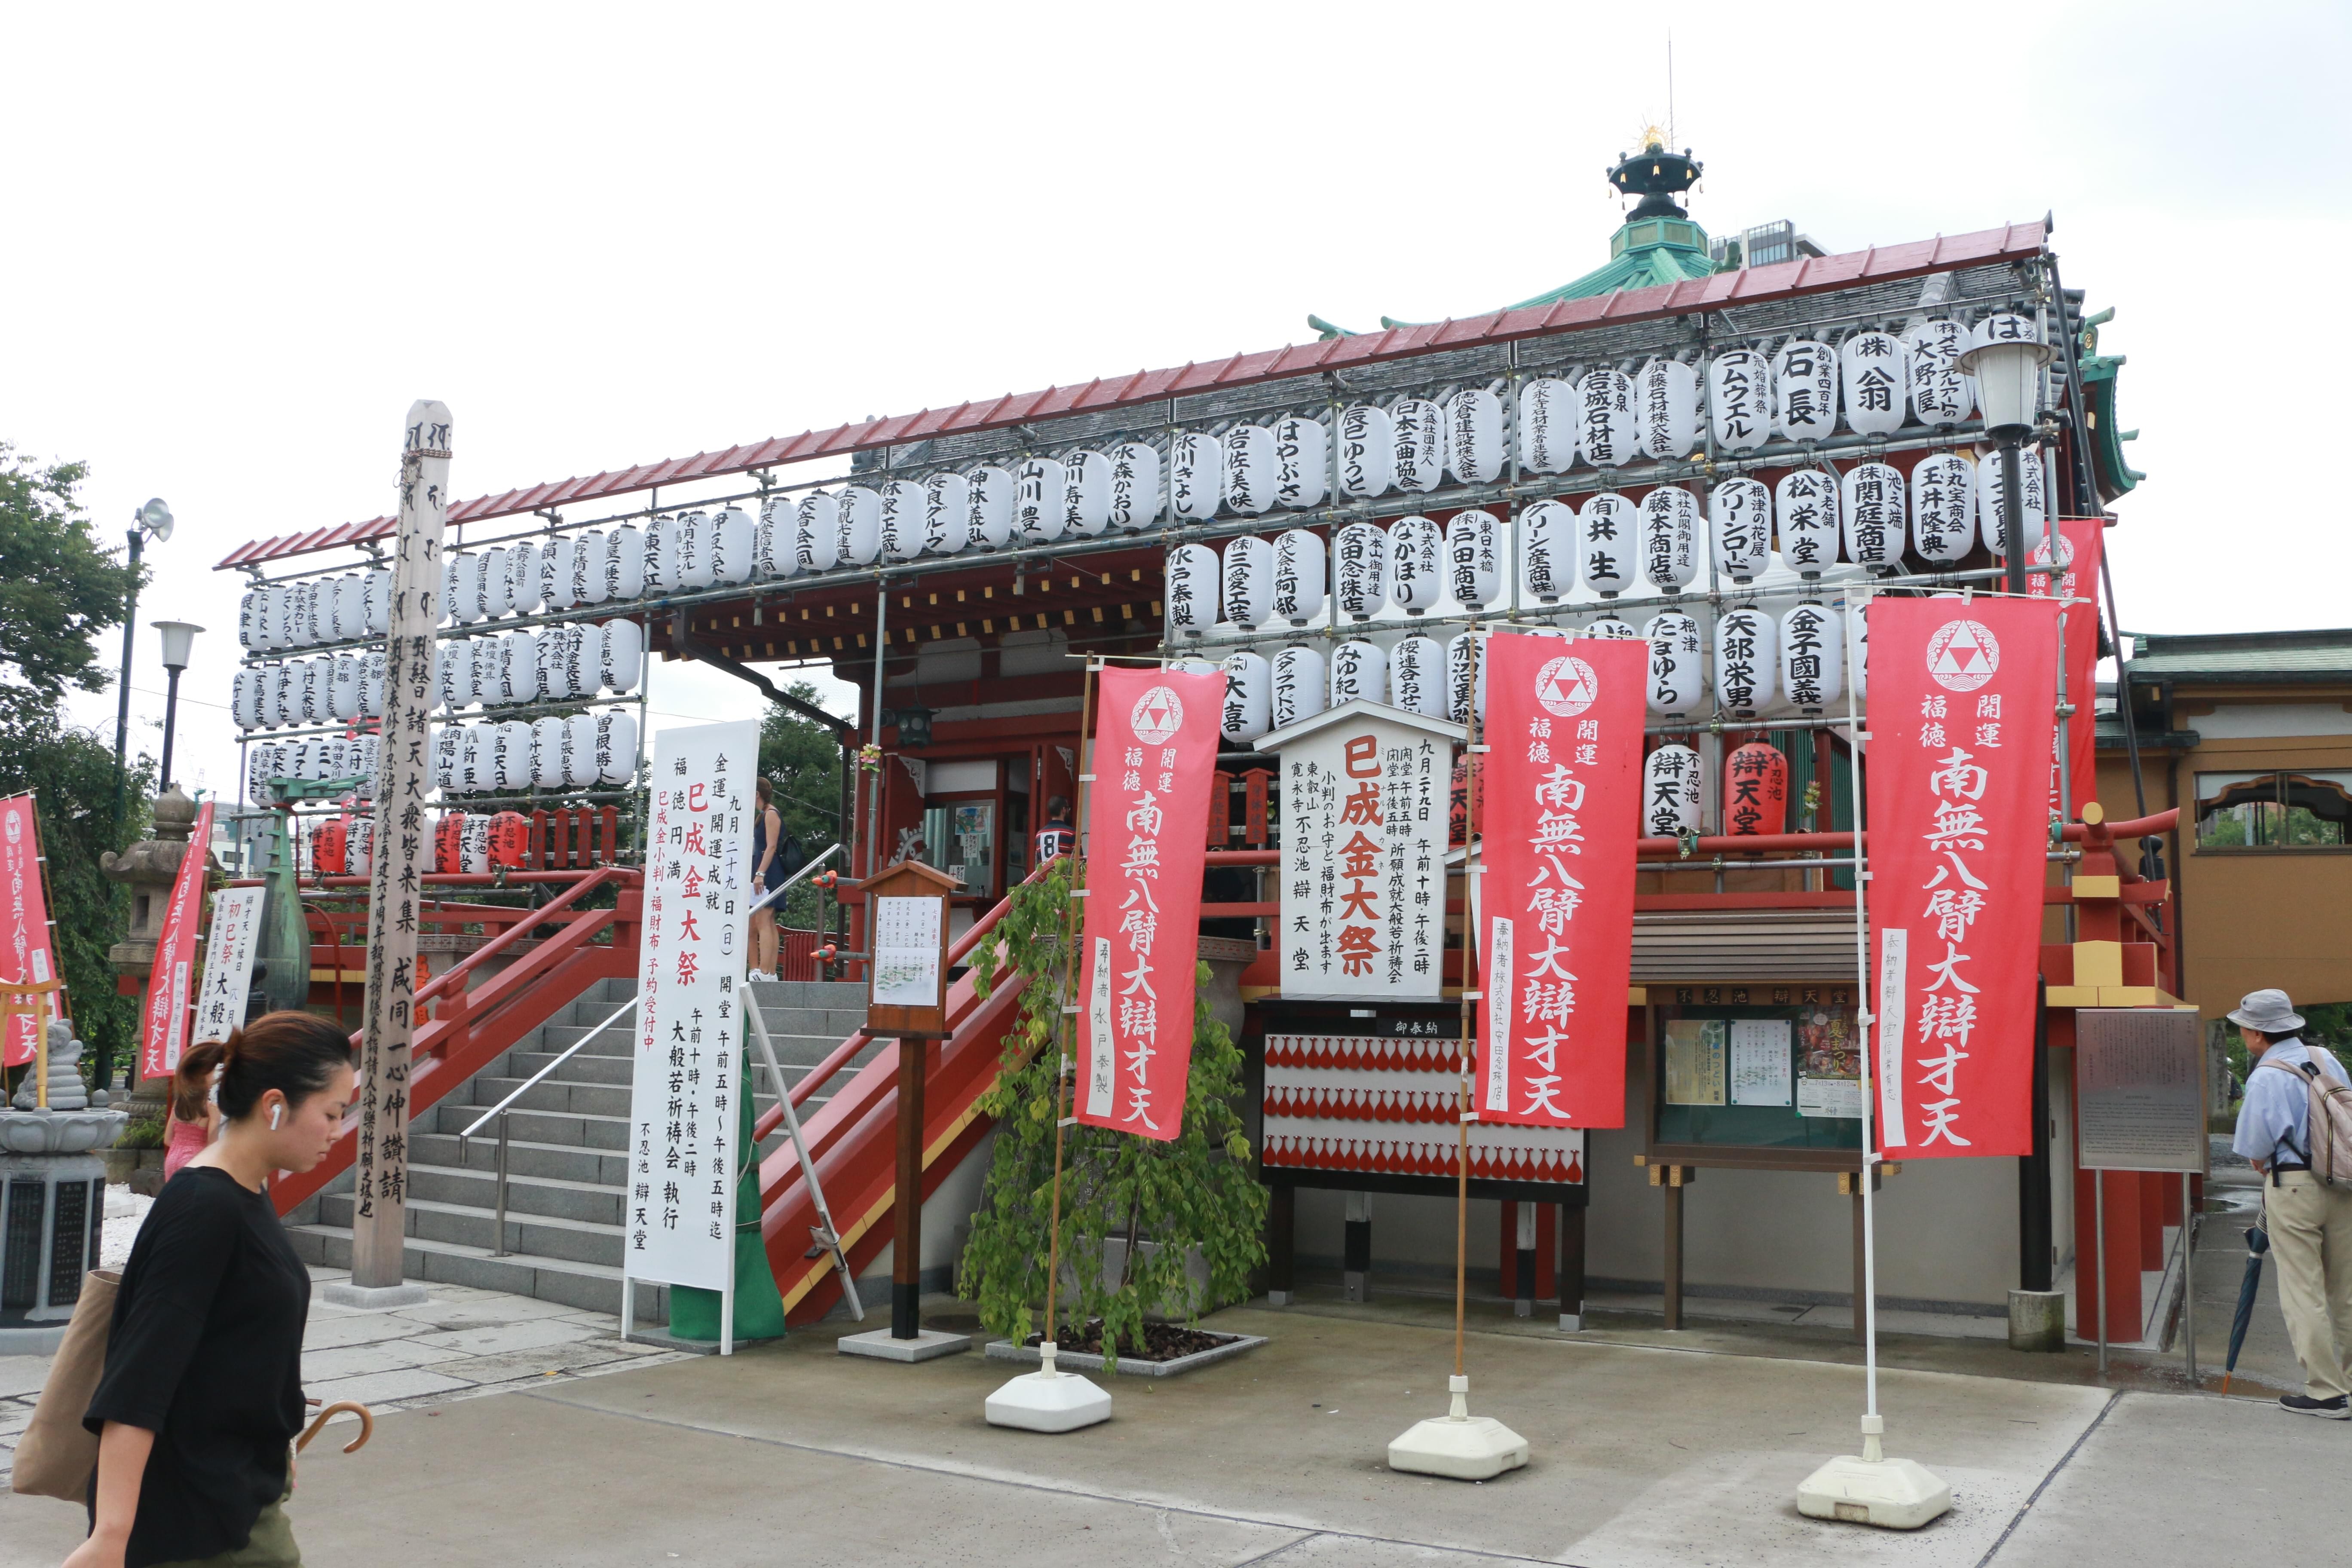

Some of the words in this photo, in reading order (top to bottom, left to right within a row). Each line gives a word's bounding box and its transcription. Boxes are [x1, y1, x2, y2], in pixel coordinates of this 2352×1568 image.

[1613, 374, 1630, 413] 喜泉
[1647, 362, 1674, 455] 須藤石材株式会社
[1752, 355, 1767, 414] 冠婚葬祭
[1782, 346, 1817, 426] 石長
[1816, 346, 1832, 417] 創業四百年
[1914, 340, 1939, 415] 大野屋
[1341, 407, 1369, 491] 辰巳ゆうと
[1394, 401, 1424, 488] 日本三曲協会
[1420, 403, 1438, 467] 公益社団法人
[1452, 392, 1480, 480] 徳倉建設株式会社
[1531, 380, 1553, 469] 寛永寺石材業者連絡会
[1583, 371, 1615, 462] 岩城石材店
[1064, 452, 1088, 528] 田川寿美
[1111, 445, 1136, 524] 水森かおり
[1174, 435, 1198, 514] 氷川きよし
[1227, 429, 1255, 508] 岩佐美咲
[1276, 420, 1301, 502] はやぶさ
[2021, 451, 2042, 511] 株式会社
[795, 496, 818, 567] 天音会一同
[836, 489, 858, 560] 上野観光連盟
[881, 481, 903, 554] 林家正蔵
[925, 472, 948, 548] 長良グループ
[966, 470, 990, 543] 神林義弘
[1019, 461, 1044, 533] 山川豊
[1675, 490, 1692, 567] 神社仏閣御用達
[1720, 481, 1754, 574] グリーンロード
[1748, 484, 1767, 558] 根津の花屋
[1786, 473, 1820, 565] 松栄堂
[1819, 477, 1836, 529] 香老舗
[1886, 472, 1903, 530] 池之端
[1919, 466, 1949, 555] 玉井隆典
[515, 546, 530, 588] 上野公園前
[540, 542, 558, 603] 韻松亭
[571, 536, 589, 599] 上野精養軒
[682, 516, 699, 571] 水月ホテル
[1274, 533, 1299, 615] 株式会社阿部
[1339, 526, 1367, 612] 安田念珠店
[1367, 527, 1383, 597] 総本山御用達
[1393, 521, 1416, 603] なかほり
[1418, 520, 1437, 573] 株式会社
[1478, 519, 1495, 573] 東日本橋
[294, 588, 306, 633] 千駄木カレー
[1169, 548, 1195, 626] 水戸奉製
[370, 656, 383, 680] 京都
[448, 642, 459, 660] 仏壇
[550, 631, 566, 670] 株式会社
[565, 626, 585, 692] 松村塗装店
[1651, 617, 1678, 704] たまゆら
[1678, 617, 1698, 654] 根津
[1722, 613, 1757, 708] 矢部栄男
[1787, 609, 1825, 705] 金子國義
[336, 660, 350, 683] 京都
[1527, 716, 1553, 764] 福徳
[1574, 719, 1599, 766] 開運
[1918, 693, 1948, 748] 福徳
[1974, 693, 2003, 748] 開運
[258, 749, 272, 800] 浅草観音裏
[438, 740, 456, 787] 陽山道
[1122, 746, 1144, 793] 福徳
[1157, 747, 1177, 793] 開運
[1306, 761, 1320, 811] 東叡山
[1418, 738, 1435, 822] 九月二十九日
[1651, 751, 1686, 837] 辯天堂
[1684, 752, 1701, 805] 不忍池
[1732, 751, 1769, 836] 辯天堂
[1766, 752, 1784, 801] 不忍池
[358, 821, 371, 854] 不忍池
[473, 820, 488, 855] 不忍池
[502, 816, 516, 849] 不忍池
[667, 757, 688, 880] 福徳円満
[1386, 781, 1400, 838] 午後五時
[1399, 781, 1413, 838] 午前五時
[1044, 835, 1055, 858] 8
[1334, 735, 1385, 978] 巳成金大祭
[676, 782, 709, 986] 巳成金大祭
[220, 900, 241, 965] 初巳祭
[1118, 790, 1164, 1131] 南無八臂大辯才天
[1518, 763, 1586, 1119] 南無八臂大辯才天
[1916, 746, 1989, 1147] 南無八臂大辯才天
[1395, 1020, 1439, 1035] 御奉納
[1679, 989, 1749, 1004] 不忍池
[637, 1123, 650, 1174] 不忍池
[633, 1182, 650, 1250] 辯天堂
[662, 1180, 680, 1231] 執行
